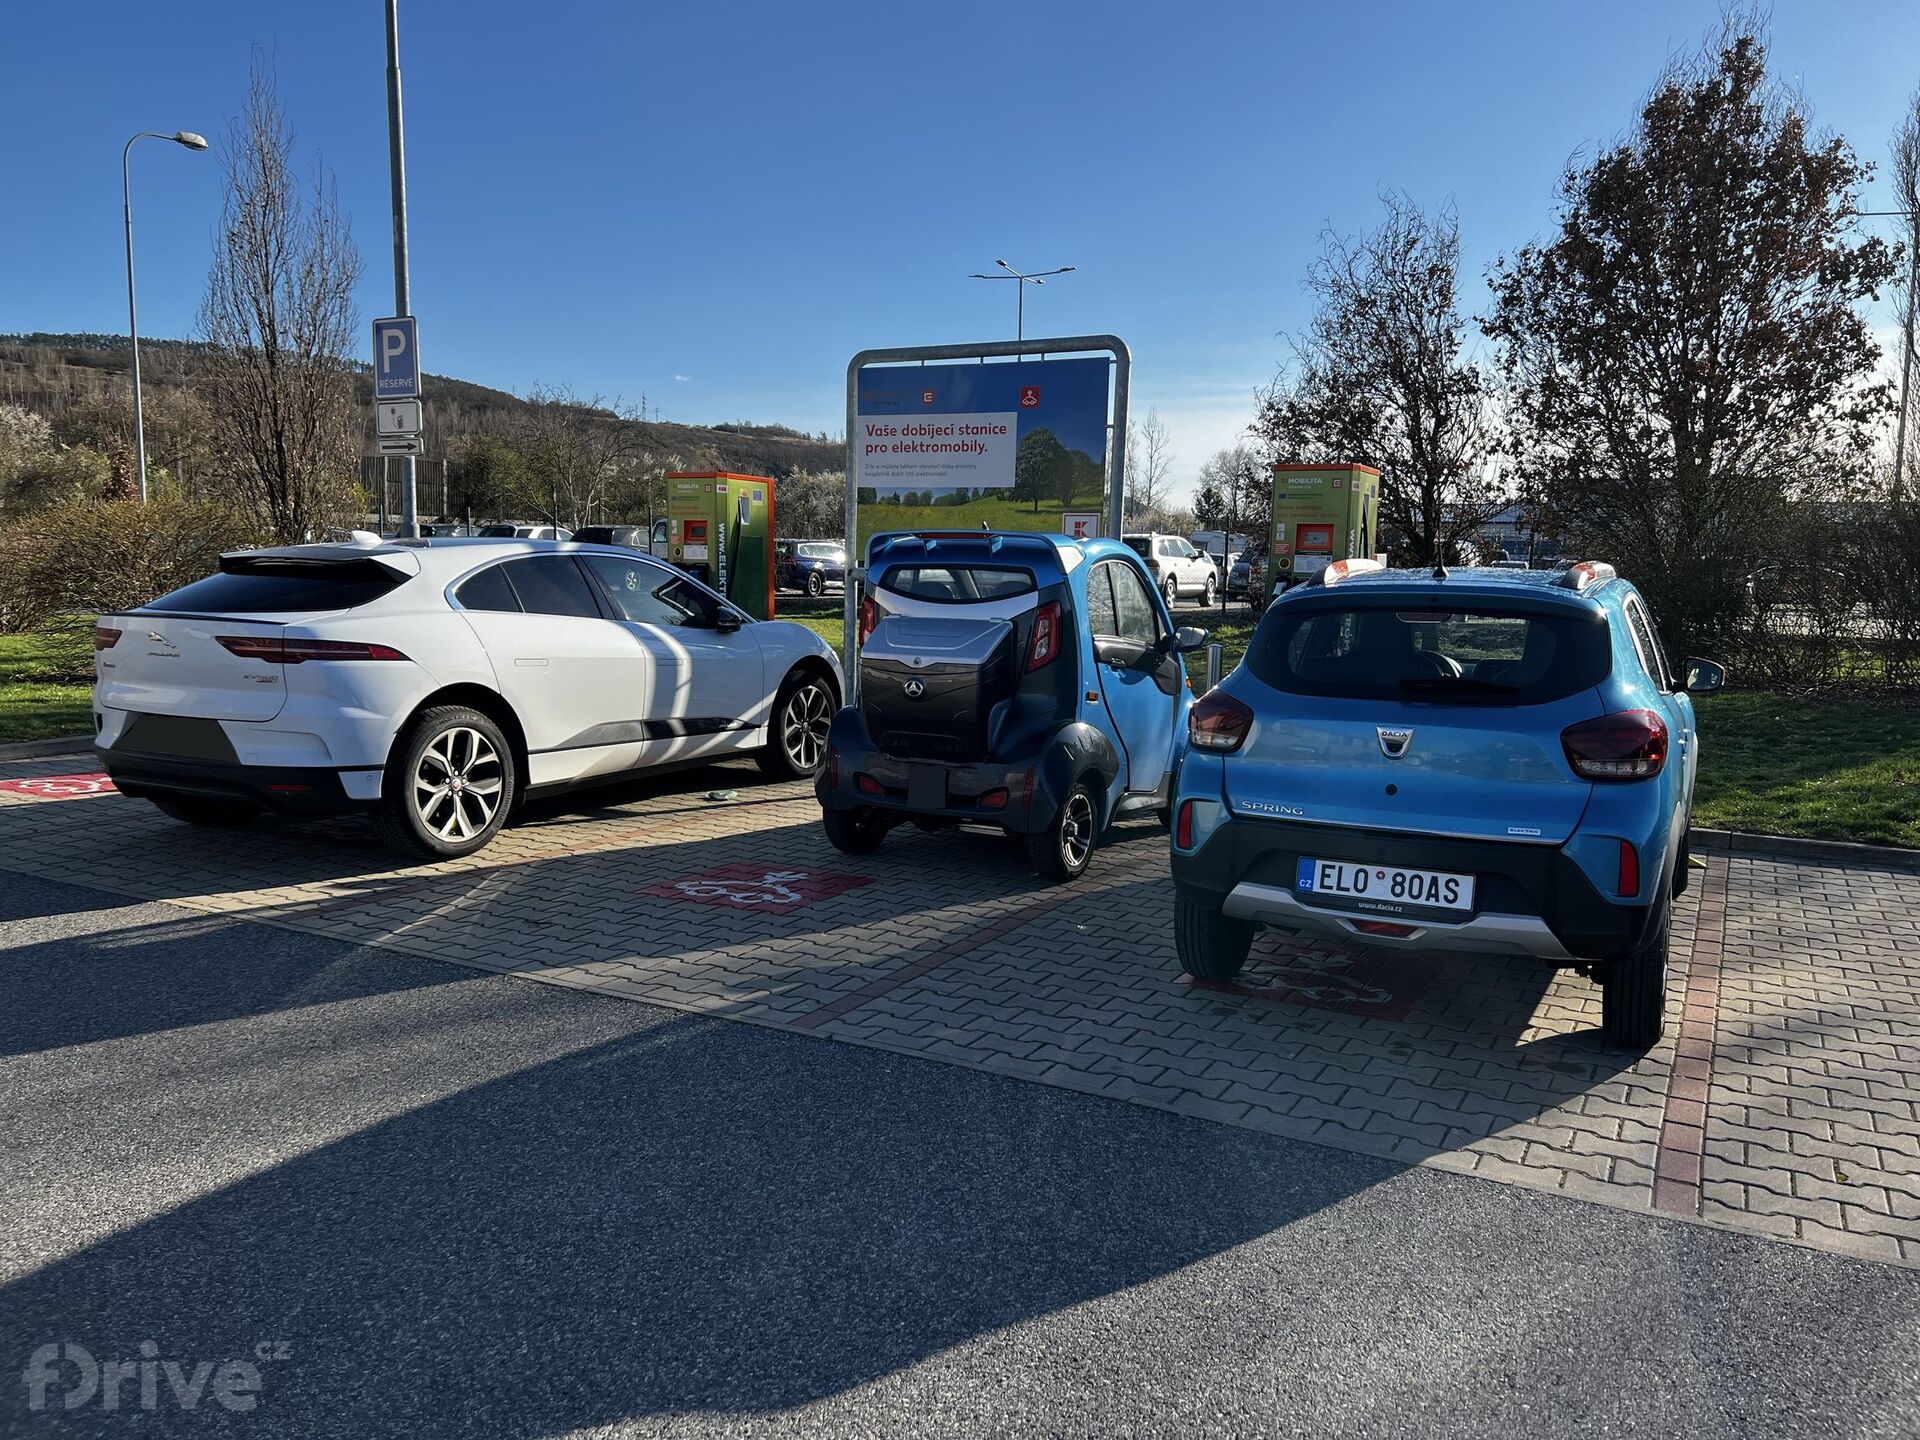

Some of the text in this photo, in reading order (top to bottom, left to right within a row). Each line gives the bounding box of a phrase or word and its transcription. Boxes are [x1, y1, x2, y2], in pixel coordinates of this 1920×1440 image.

[382, 328, 406, 374] P
[379, 376, 413, 389] RÉSERVÉ
[866, 422, 1007, 439] Vaše dobíjecí stanice
[865, 440, 988, 456] pro elektromobily.
[1241, 800, 1304, 815] SPRING
[1299, 879, 1312, 888] CZ
[1390, 871, 1460, 905] 80AS
[1358, 901, 1402, 912] www.dacia.cz
